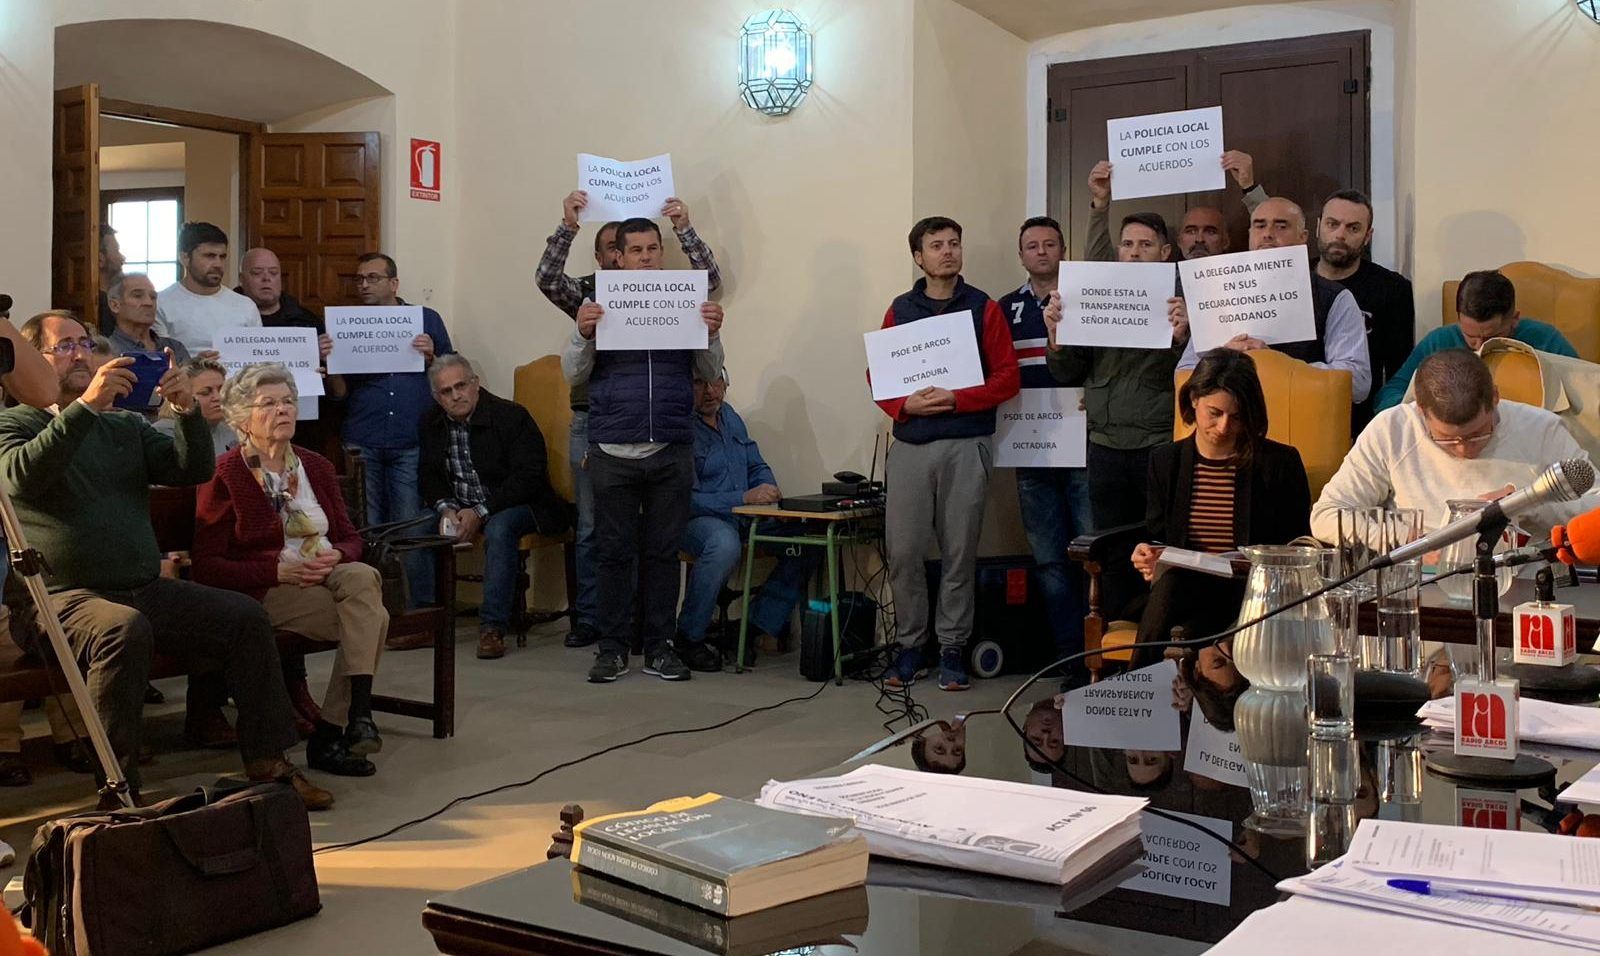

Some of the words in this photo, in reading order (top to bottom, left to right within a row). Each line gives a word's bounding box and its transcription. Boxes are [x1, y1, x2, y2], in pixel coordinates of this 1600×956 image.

[1120, 131, 1132, 140] LA
[1134, 126, 1173, 138] POLICIA
[1177, 122, 1210, 133] LOCAL
[1121, 144, 1162, 157] CUMPLE
[1165, 141, 1187, 152] CON
[1191, 138, 1210, 149] LOS
[1138, 158, 1193, 172] ACUERDOS
[588, 165, 598, 173] LA
[600, 166, 632, 178] POLICIA
[634, 165, 661, 177] LOCAL
[588, 178, 623, 190] CUMPLE
[625, 182, 644, 191] CON
[646, 177, 662, 186] LOS
[412, 191, 438, 200] EXTINTOR
[604, 192, 650, 203] ACUERDOS
[1194, 271, 1204, 279] LA
[1206, 264, 1252, 277] DELEGADA
[1254, 259, 1293, 271] MIENTE
[607, 284, 620, 292] LA
[622, 284, 661, 292] POLICIA
[665, 284, 696, 292] LOCAL
[1224, 282, 1235, 291] EN
[1238, 279, 1257, 289] SUS
[1082, 288, 1112, 296] DONDE
[1114, 289, 1134, 297] ESTA
[1269, 293, 1276, 301] A
[1279, 291, 1298, 300] LOS
[609, 300, 650, 309] CUMPLE
[653, 300, 675, 309] CON
[678, 300, 696, 309] LOS
[1080, 302, 1150, 311] TRANSPARENCIA
[1011, 301, 1024, 324] 7
[336, 317, 347, 325] LA
[349, 317, 383, 325] POLICIA
[625, 317, 679, 326] ACUERDOS
[1081, 315, 1109, 324] SEÑOR
[337, 331, 373, 339] CUMPLE
[397, 330, 413, 338] LOS
[236, 336, 276, 344] DELEGADA
[352, 345, 399, 353] ACUERDOS
[891, 347, 910, 358] PSOE
[912, 344, 922, 352] DE
[924, 337, 951, 349] ARCOS
[904, 367, 948, 384] DICTADURA
[1037, 412, 1063, 420] ARCOS
[1012, 442, 1057, 450] DICTADURA
